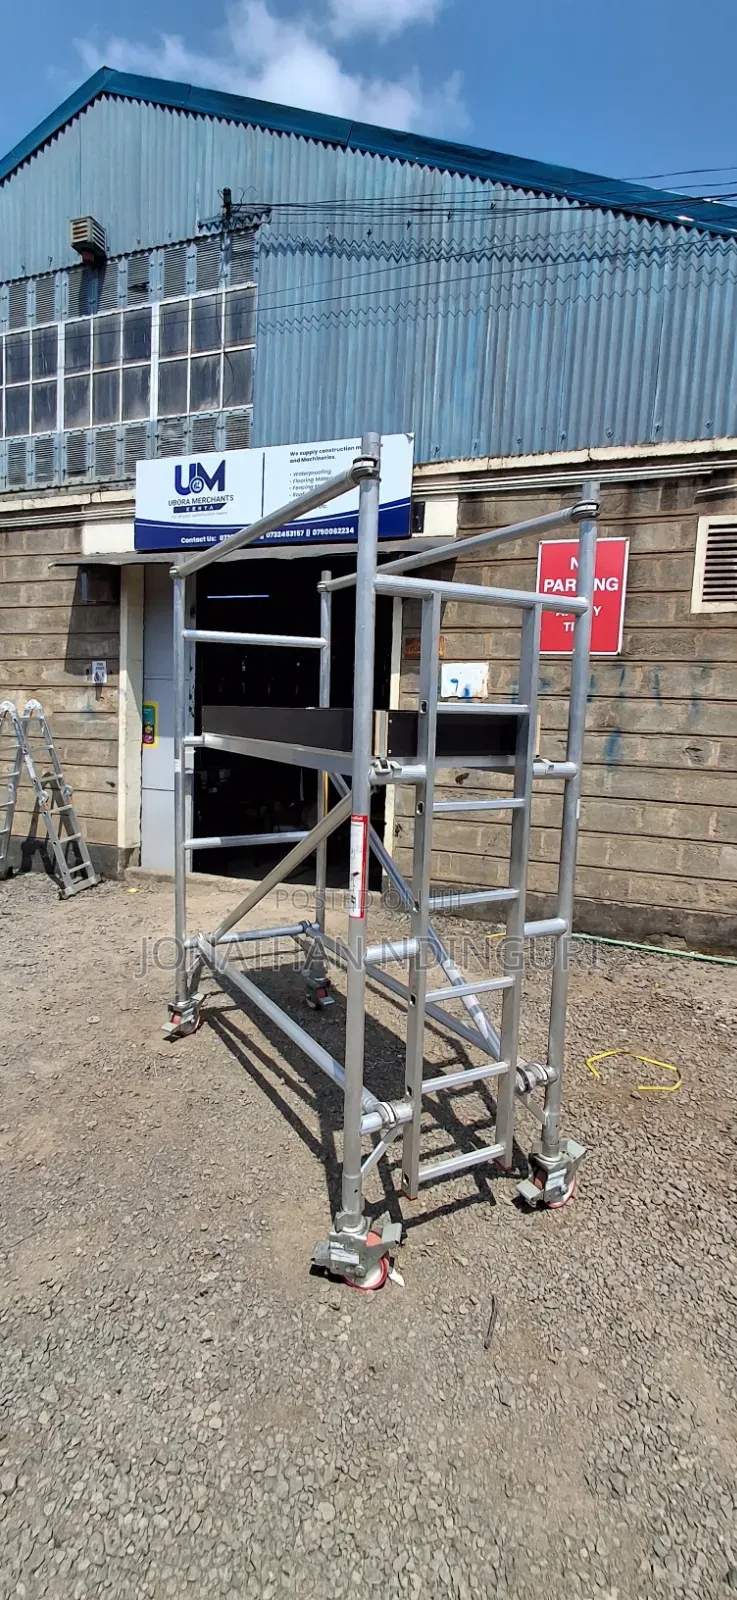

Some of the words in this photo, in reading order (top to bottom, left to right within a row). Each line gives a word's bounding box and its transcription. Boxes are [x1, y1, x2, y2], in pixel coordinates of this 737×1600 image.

[319, 446, 355, 454] construction
[293, 469, 332, 477] Waterproofing
[168, 498, 191, 507] UBORA
[192, 495, 234, 505] MERCHANTS
[180, 535, 206, 544] Contact
[543, 577, 619, 592] PARNG
